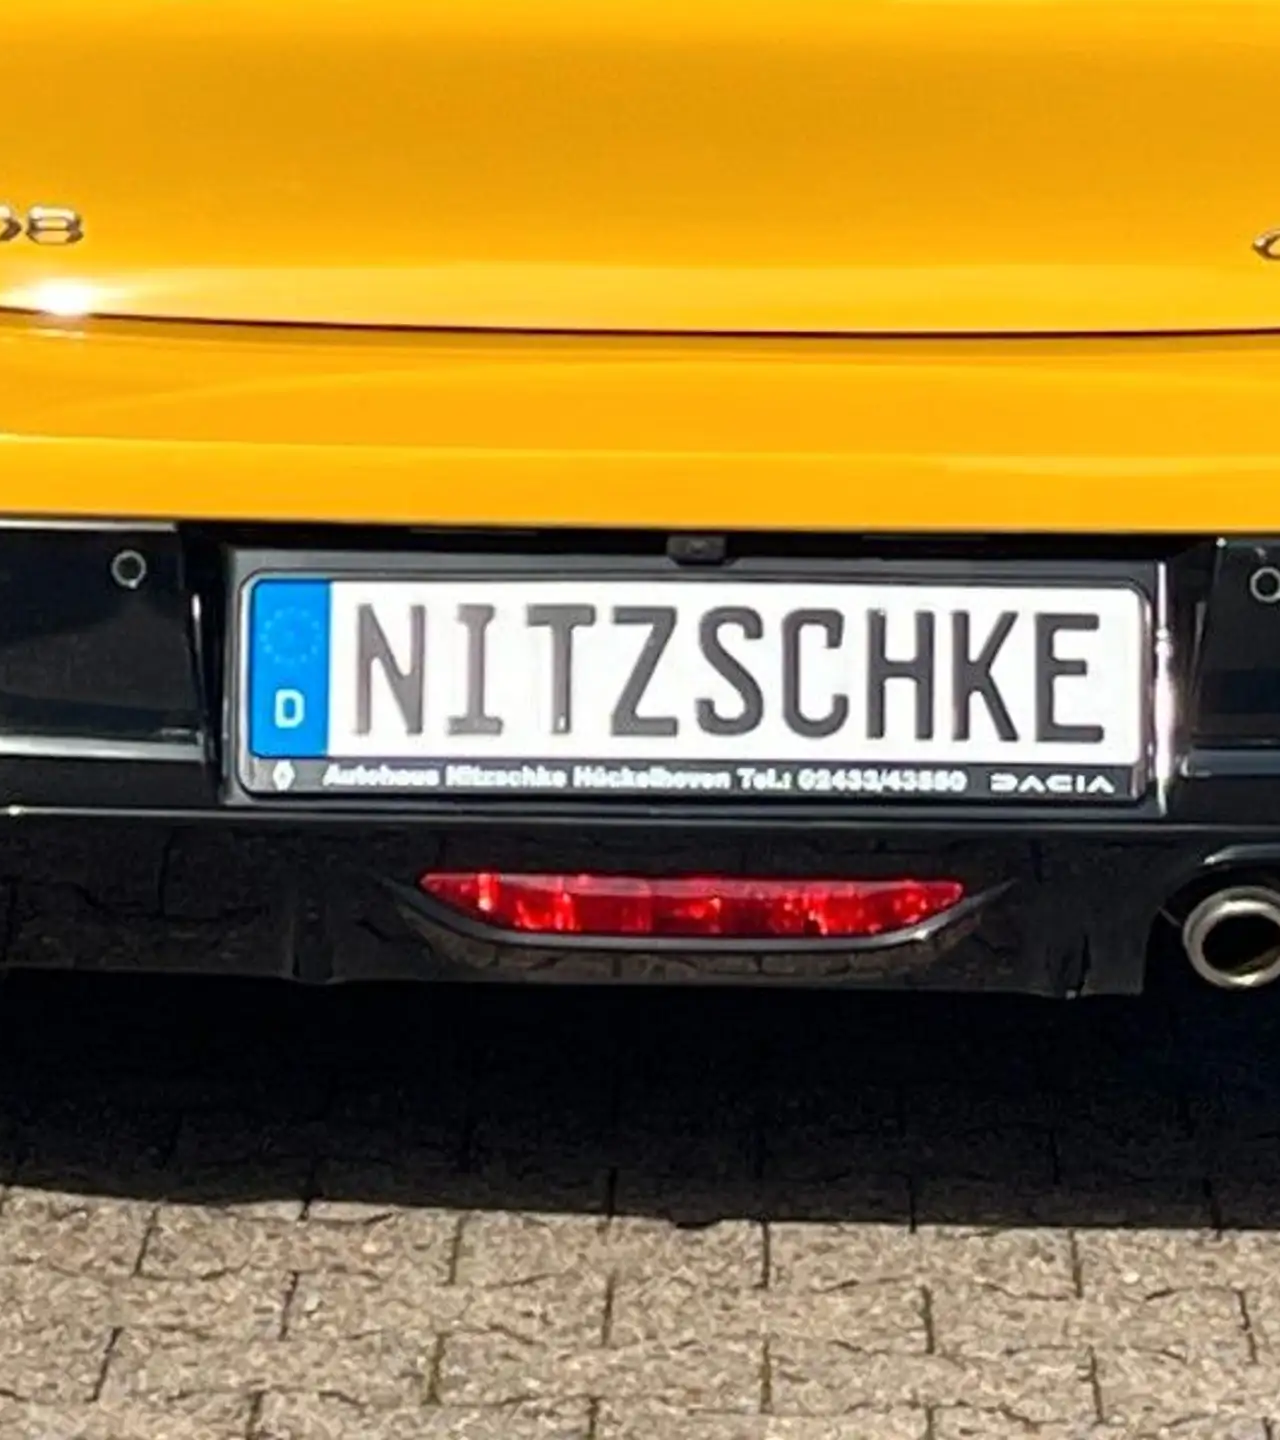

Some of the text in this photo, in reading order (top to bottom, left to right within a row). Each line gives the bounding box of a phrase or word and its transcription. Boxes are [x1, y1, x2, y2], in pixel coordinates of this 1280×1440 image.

[275, 602, 1105, 744] D NITZSCHKE
[322, 763, 440, 787] Autohaus
[446, 765, 567, 788] Nitzschke
[989, 773, 1115, 794] DACIA
